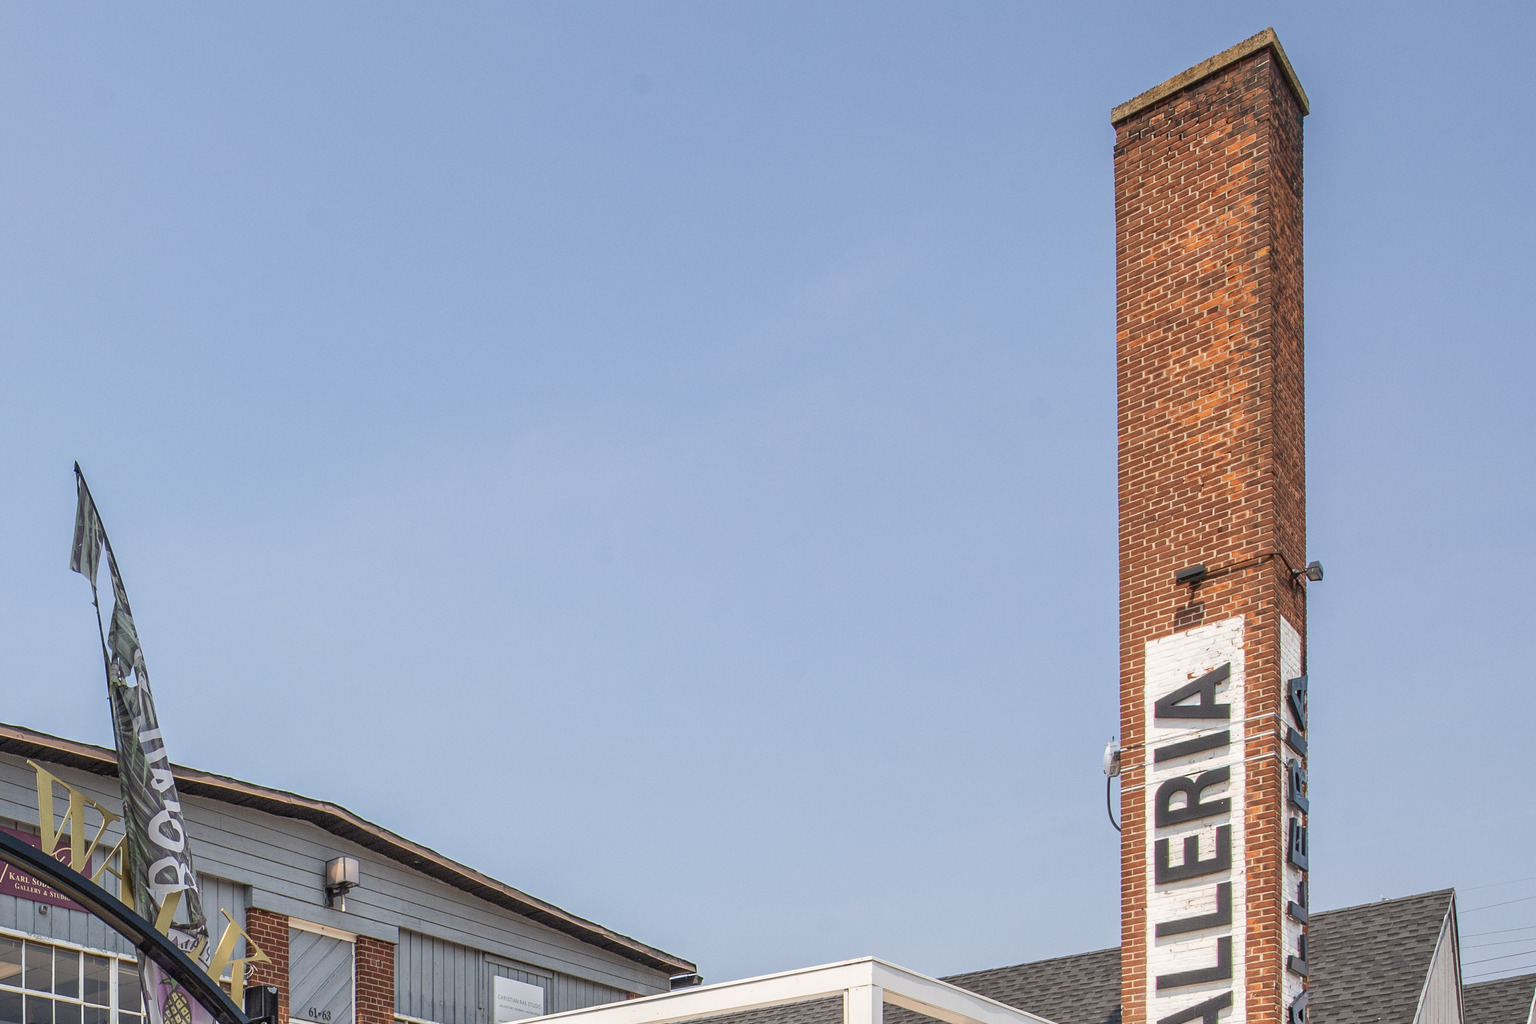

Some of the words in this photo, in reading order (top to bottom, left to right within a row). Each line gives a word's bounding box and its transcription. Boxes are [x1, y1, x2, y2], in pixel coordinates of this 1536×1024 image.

[8, 871, 31, 884] KARL
[14, 882, 42, 895] GALLERY
[308, 1006, 332, 1021] 61-63
